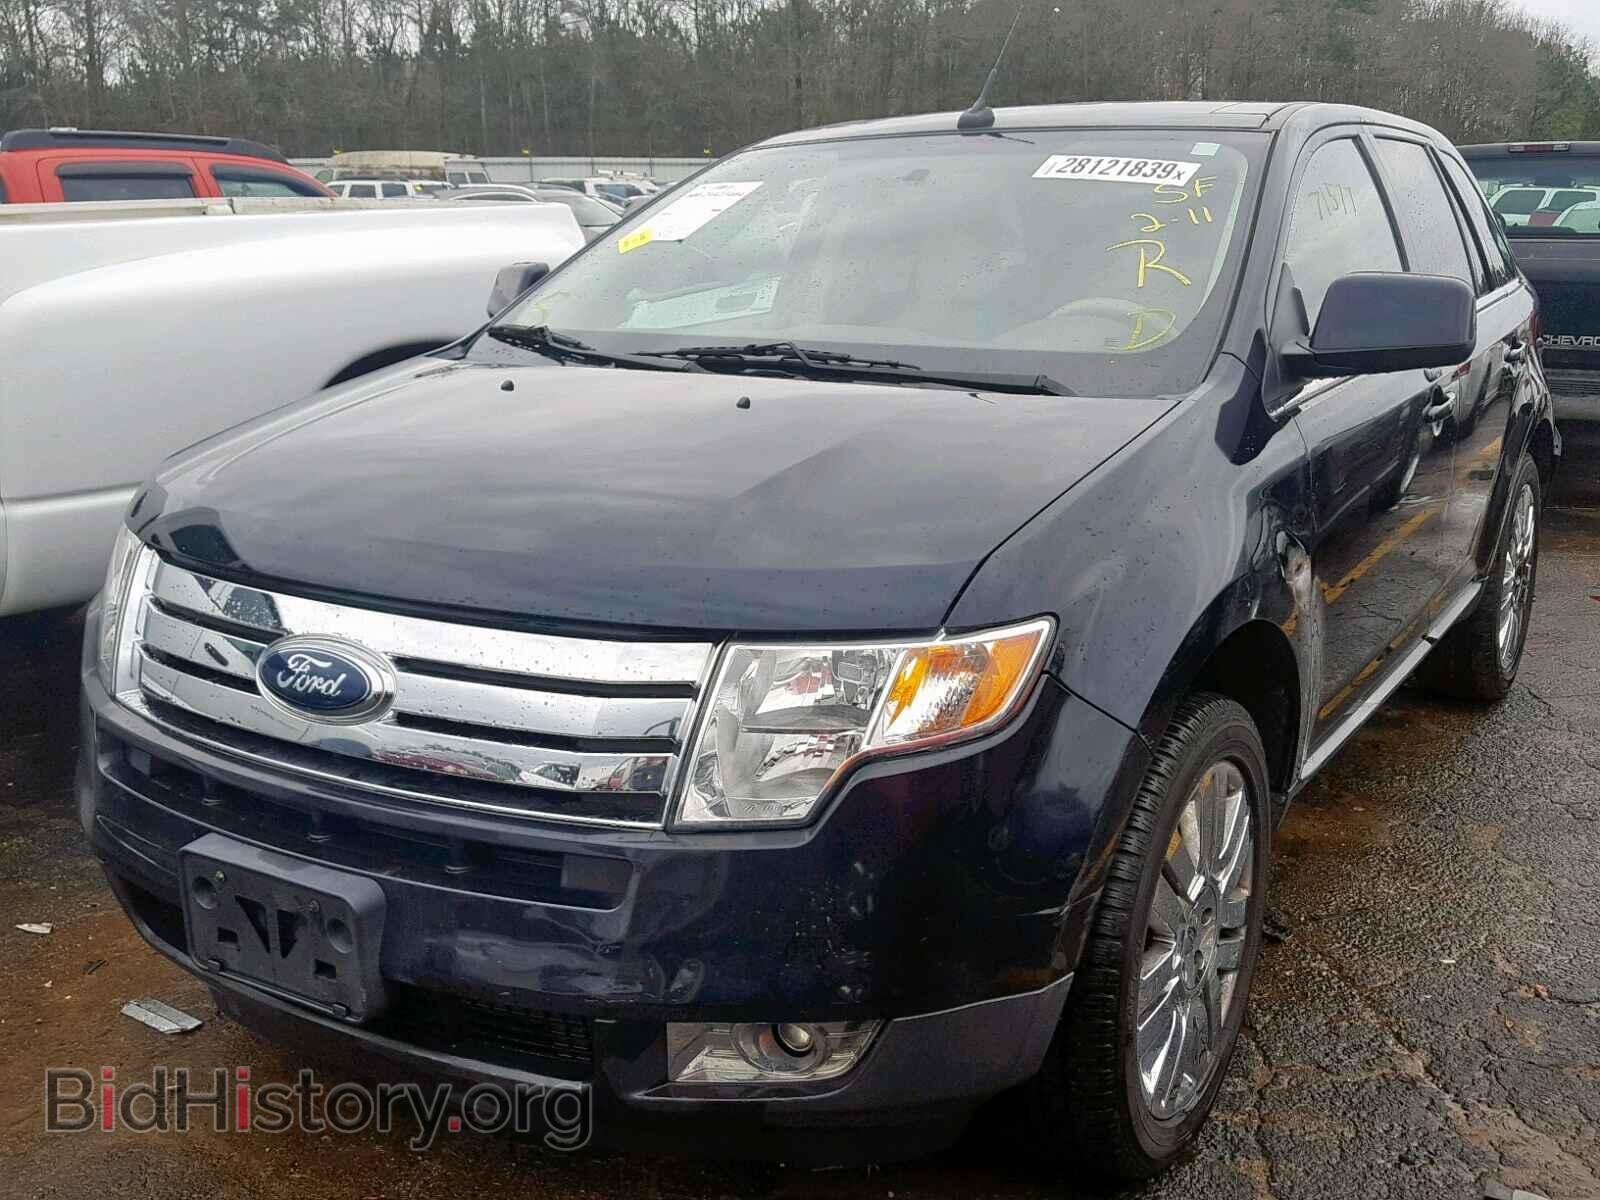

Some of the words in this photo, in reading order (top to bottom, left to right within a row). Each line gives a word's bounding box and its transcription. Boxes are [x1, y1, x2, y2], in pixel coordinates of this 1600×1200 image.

[1153, 176, 1217, 204] SF
[1105, 239, 1192, 288] R
[1120, 307, 1177, 351] D
[277, 653, 347, 697] Ford
